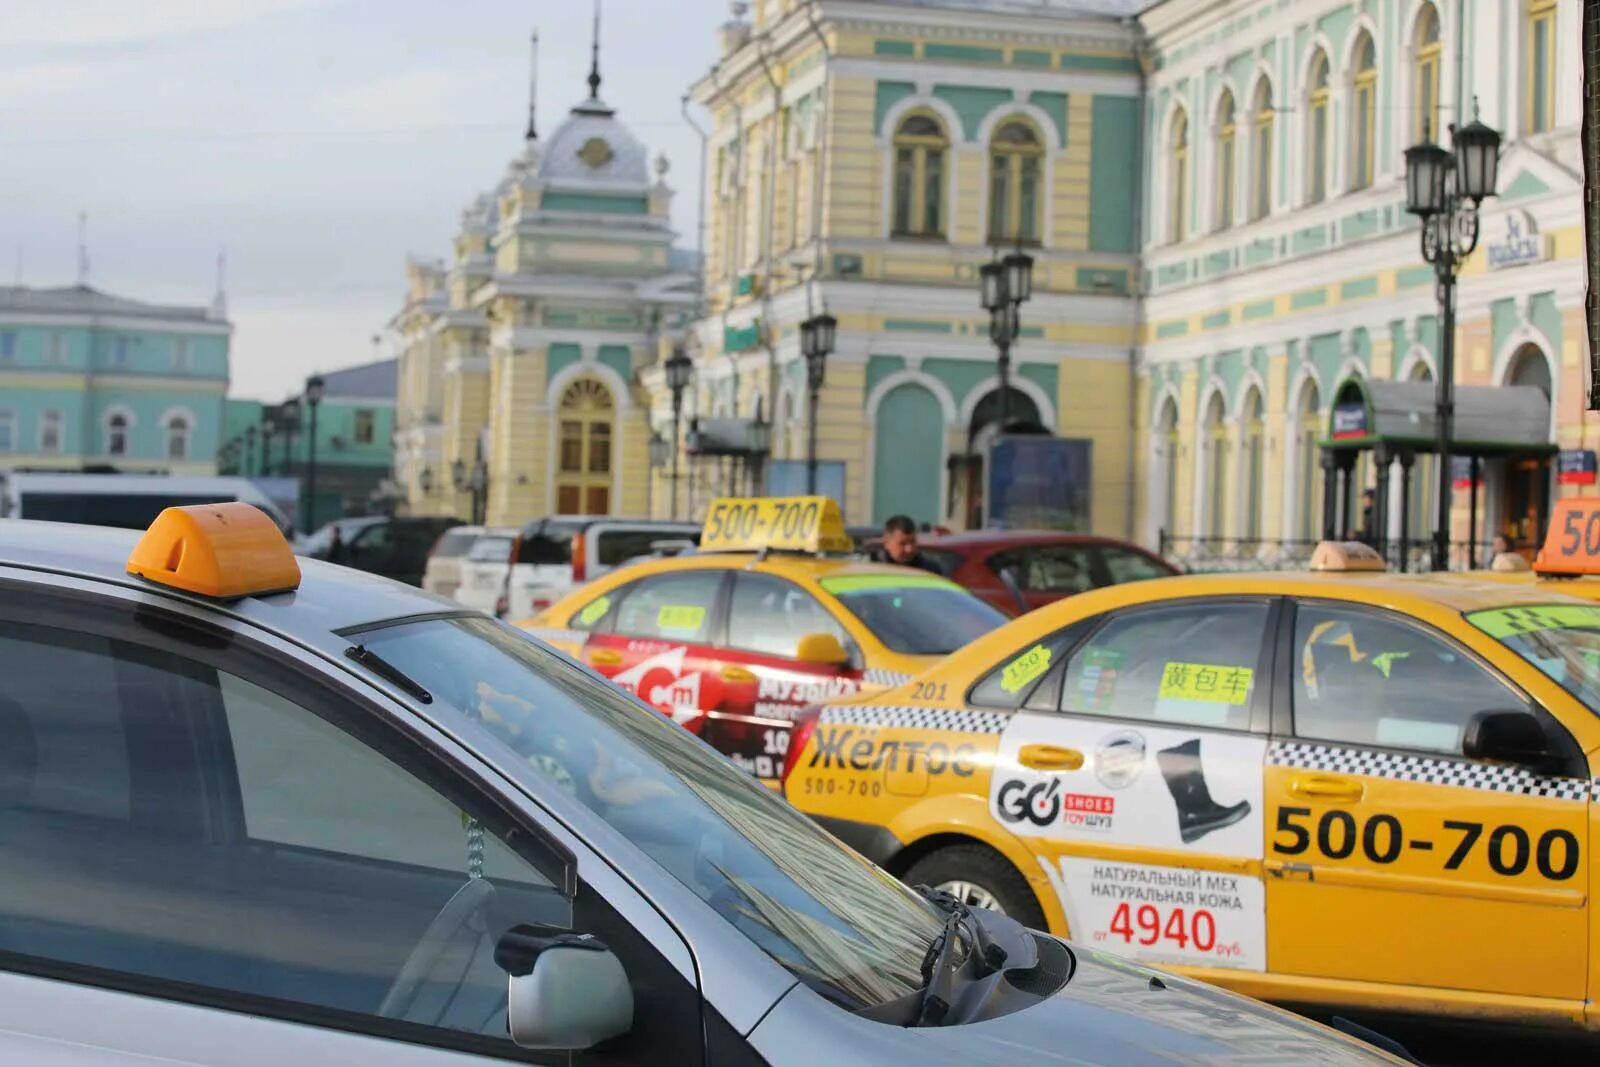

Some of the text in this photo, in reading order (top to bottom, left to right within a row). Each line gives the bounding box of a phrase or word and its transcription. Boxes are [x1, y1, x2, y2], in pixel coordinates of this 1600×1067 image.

[708, 502, 818, 541] 500-700
[1561, 511, 1600, 556] 50
[911, 681, 948, 701] 201
[1166, 665, 1249, 695] 黄包车
[804, 777, 881, 797] 500-700
[1065, 795, 1113, 812] SHOES
[1272, 805, 1579, 881] 500-700
[1093, 866, 1238, 892] НАТУРАЛЬНЫЙ МЕХ
[1091, 883, 1243, 910] НАТУРАЛЬНАЯ КОЖА
[1110, 902, 1216, 952] 4940
